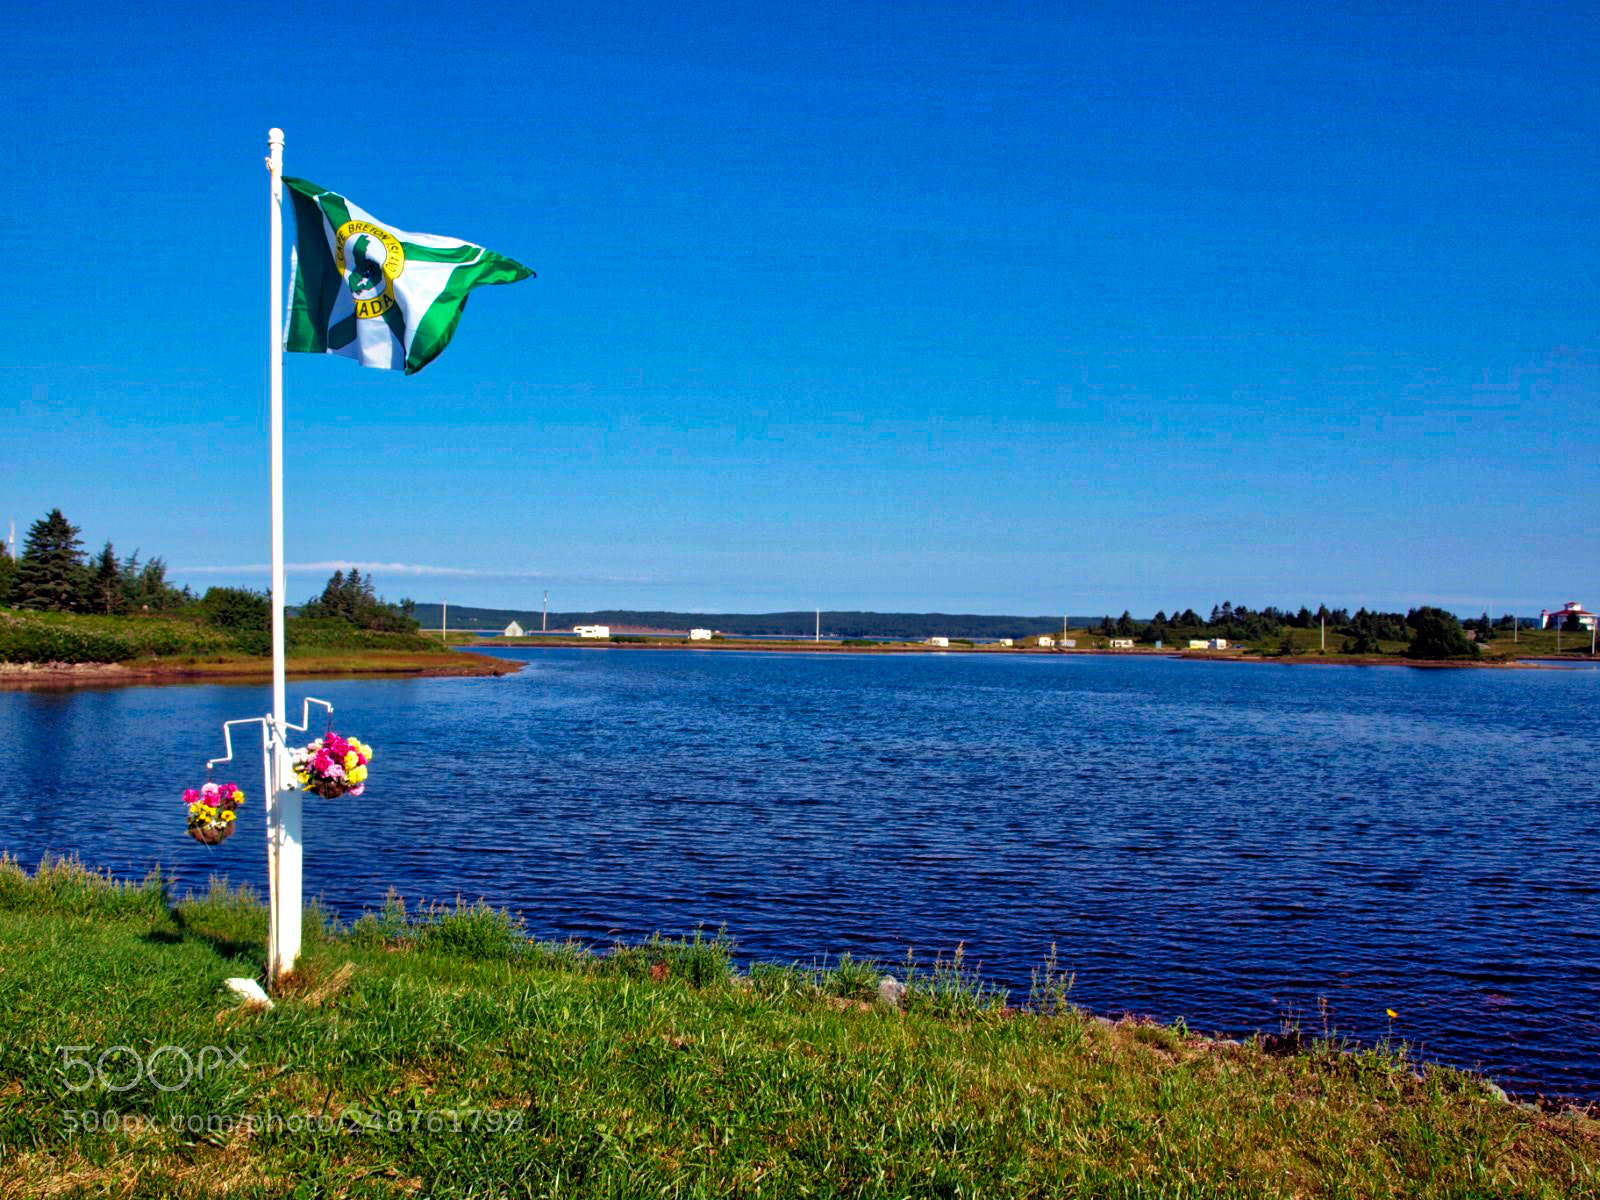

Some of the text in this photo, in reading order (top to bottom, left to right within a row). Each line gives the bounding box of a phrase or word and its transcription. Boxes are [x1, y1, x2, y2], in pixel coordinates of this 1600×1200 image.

[337, 231, 346, 261] CAPE
[348, 223, 391, 240] BRETON
[356, 294, 393, 316] ADA
